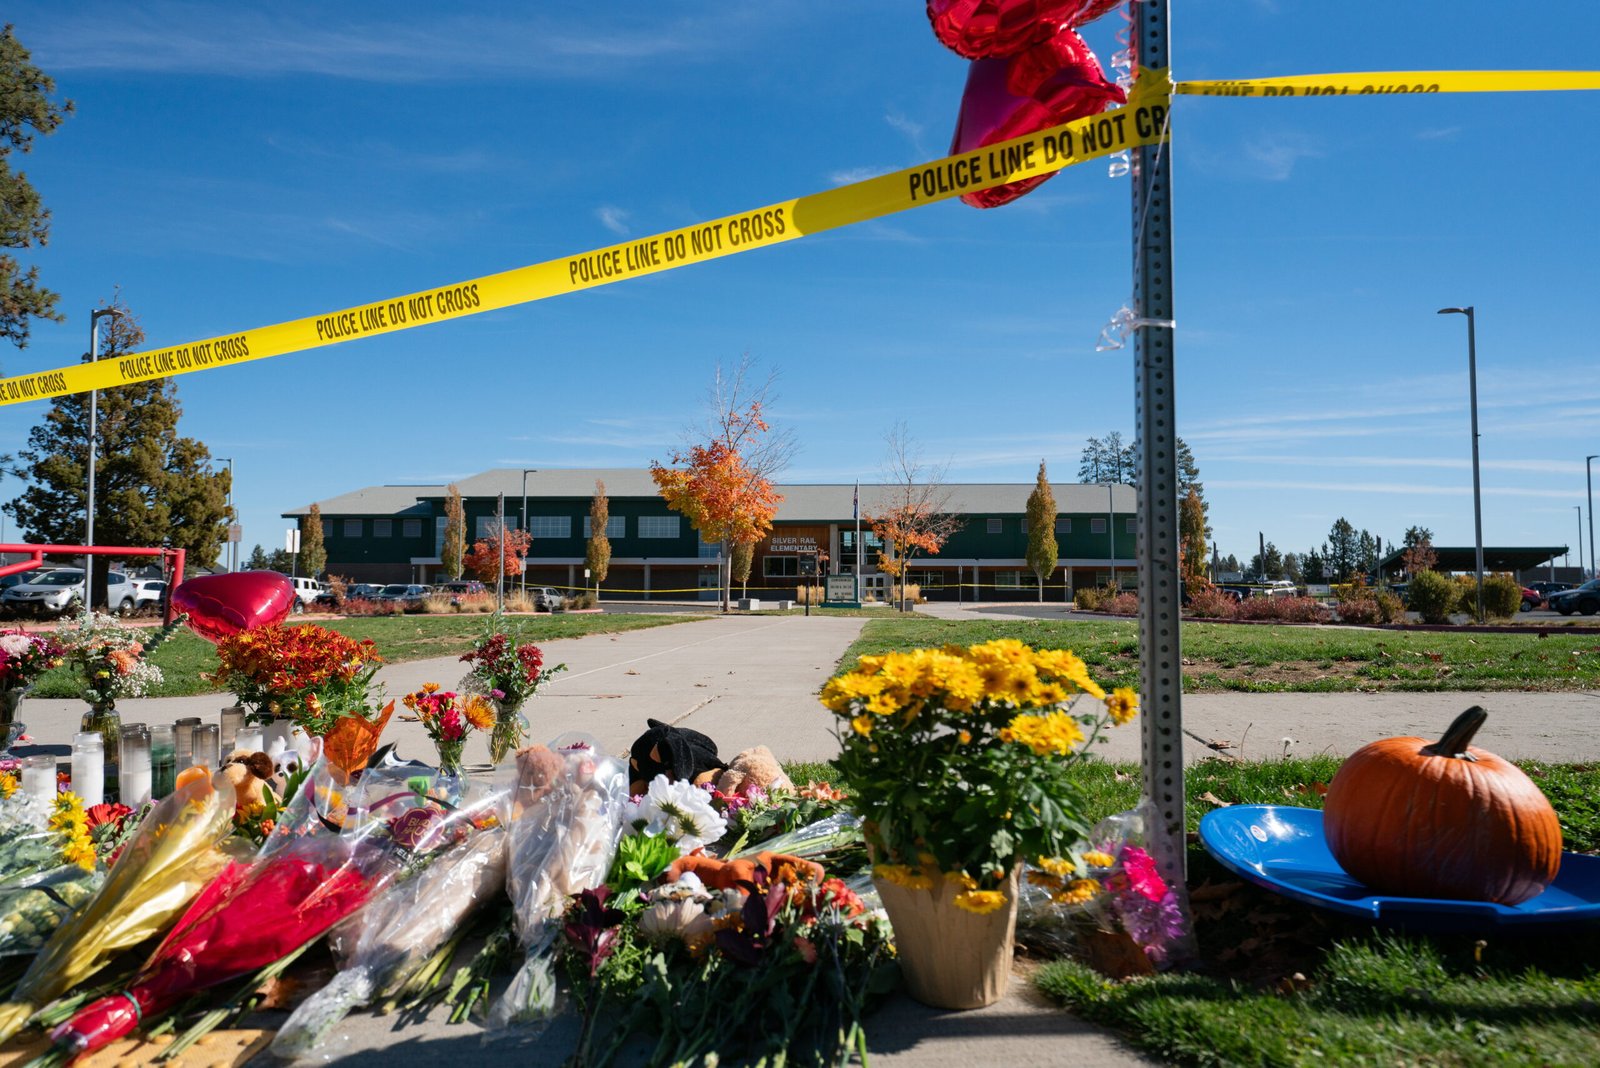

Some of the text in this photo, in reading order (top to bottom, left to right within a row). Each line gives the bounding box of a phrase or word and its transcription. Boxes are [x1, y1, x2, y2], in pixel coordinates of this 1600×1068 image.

[909, 156, 982, 201] POLICE
[988, 141, 1036, 180] LINE
[1043, 130, 1073, 164] DO
[1081, 114, 1126, 155] NOT
[569, 208, 785, 284] POLICE LINE DO NOT CROSS
[316, 283, 480, 341] POLICE LINE DO NOT CROSS
[7, 381, 20, 399] DO
[19, 378, 37, 397] NOT
[37, 372, 67, 394] CROSS
[119, 335, 249, 380] POLICE LINE DO NOT CROSS
